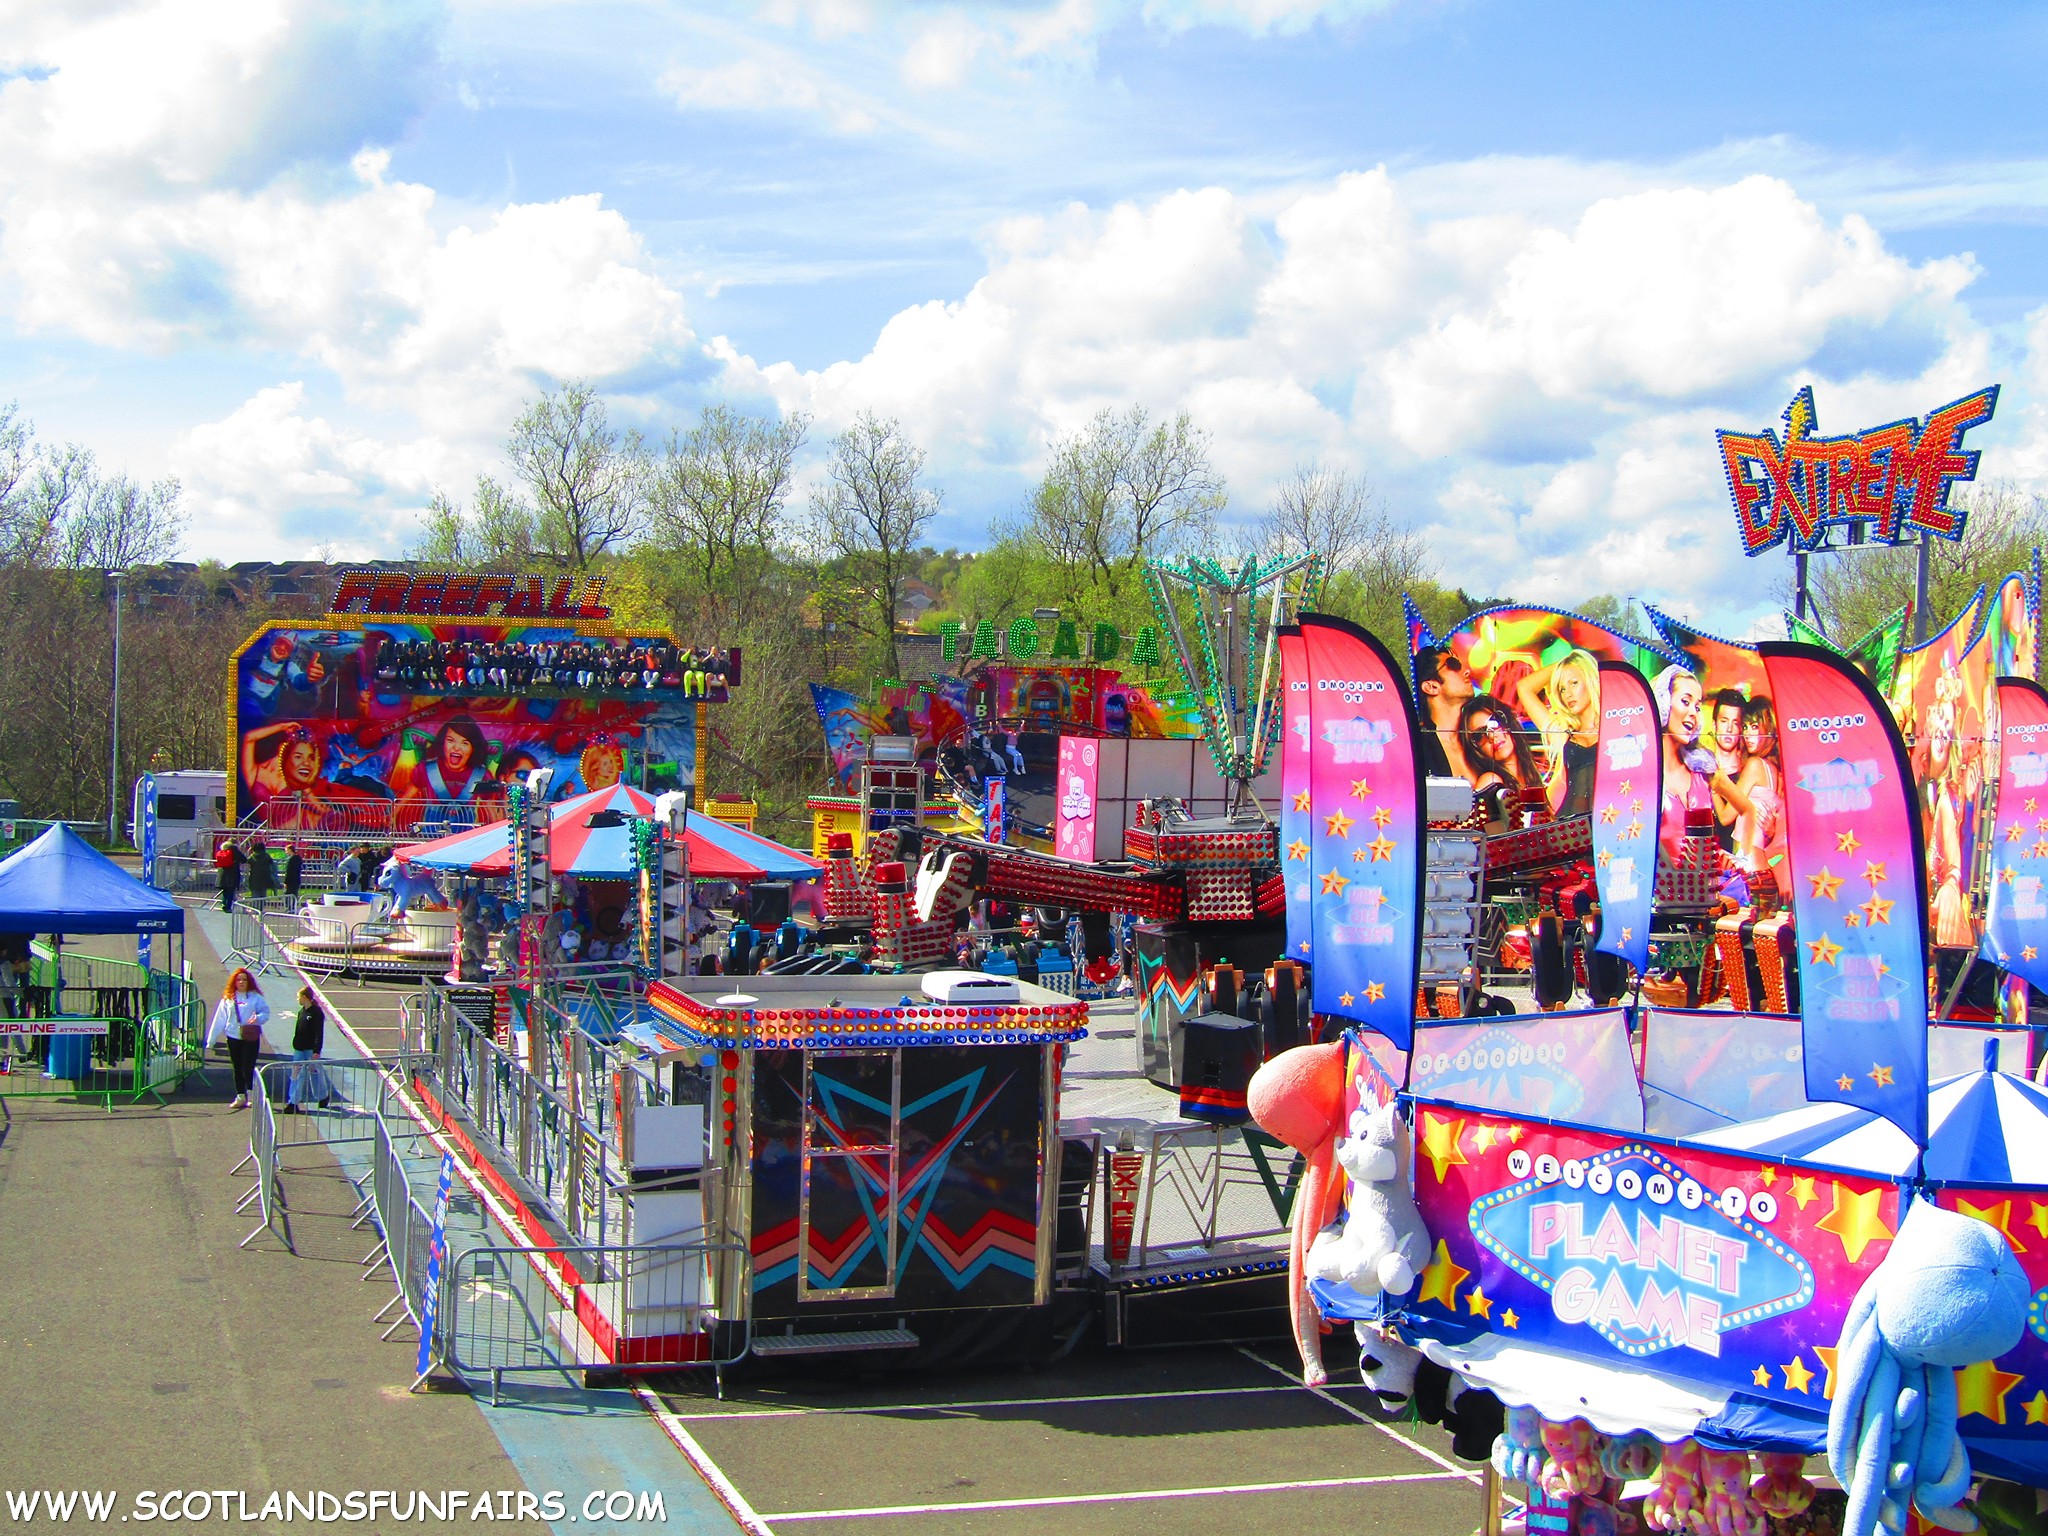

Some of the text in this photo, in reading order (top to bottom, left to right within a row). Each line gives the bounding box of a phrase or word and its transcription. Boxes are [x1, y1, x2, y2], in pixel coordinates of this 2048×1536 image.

[1716, 384, 2001, 557] EXTREME
[329, 570, 611, 620] FREEFALL
[940, 618, 1160, 667] TAGADA
[1112, 1156, 1142, 1259] EXTREME
[1509, 1153, 1773, 1219] WELCOME TO
[1530, 1202, 1747, 1297] PLANET
[1552, 1267, 1721, 1358] GAME
